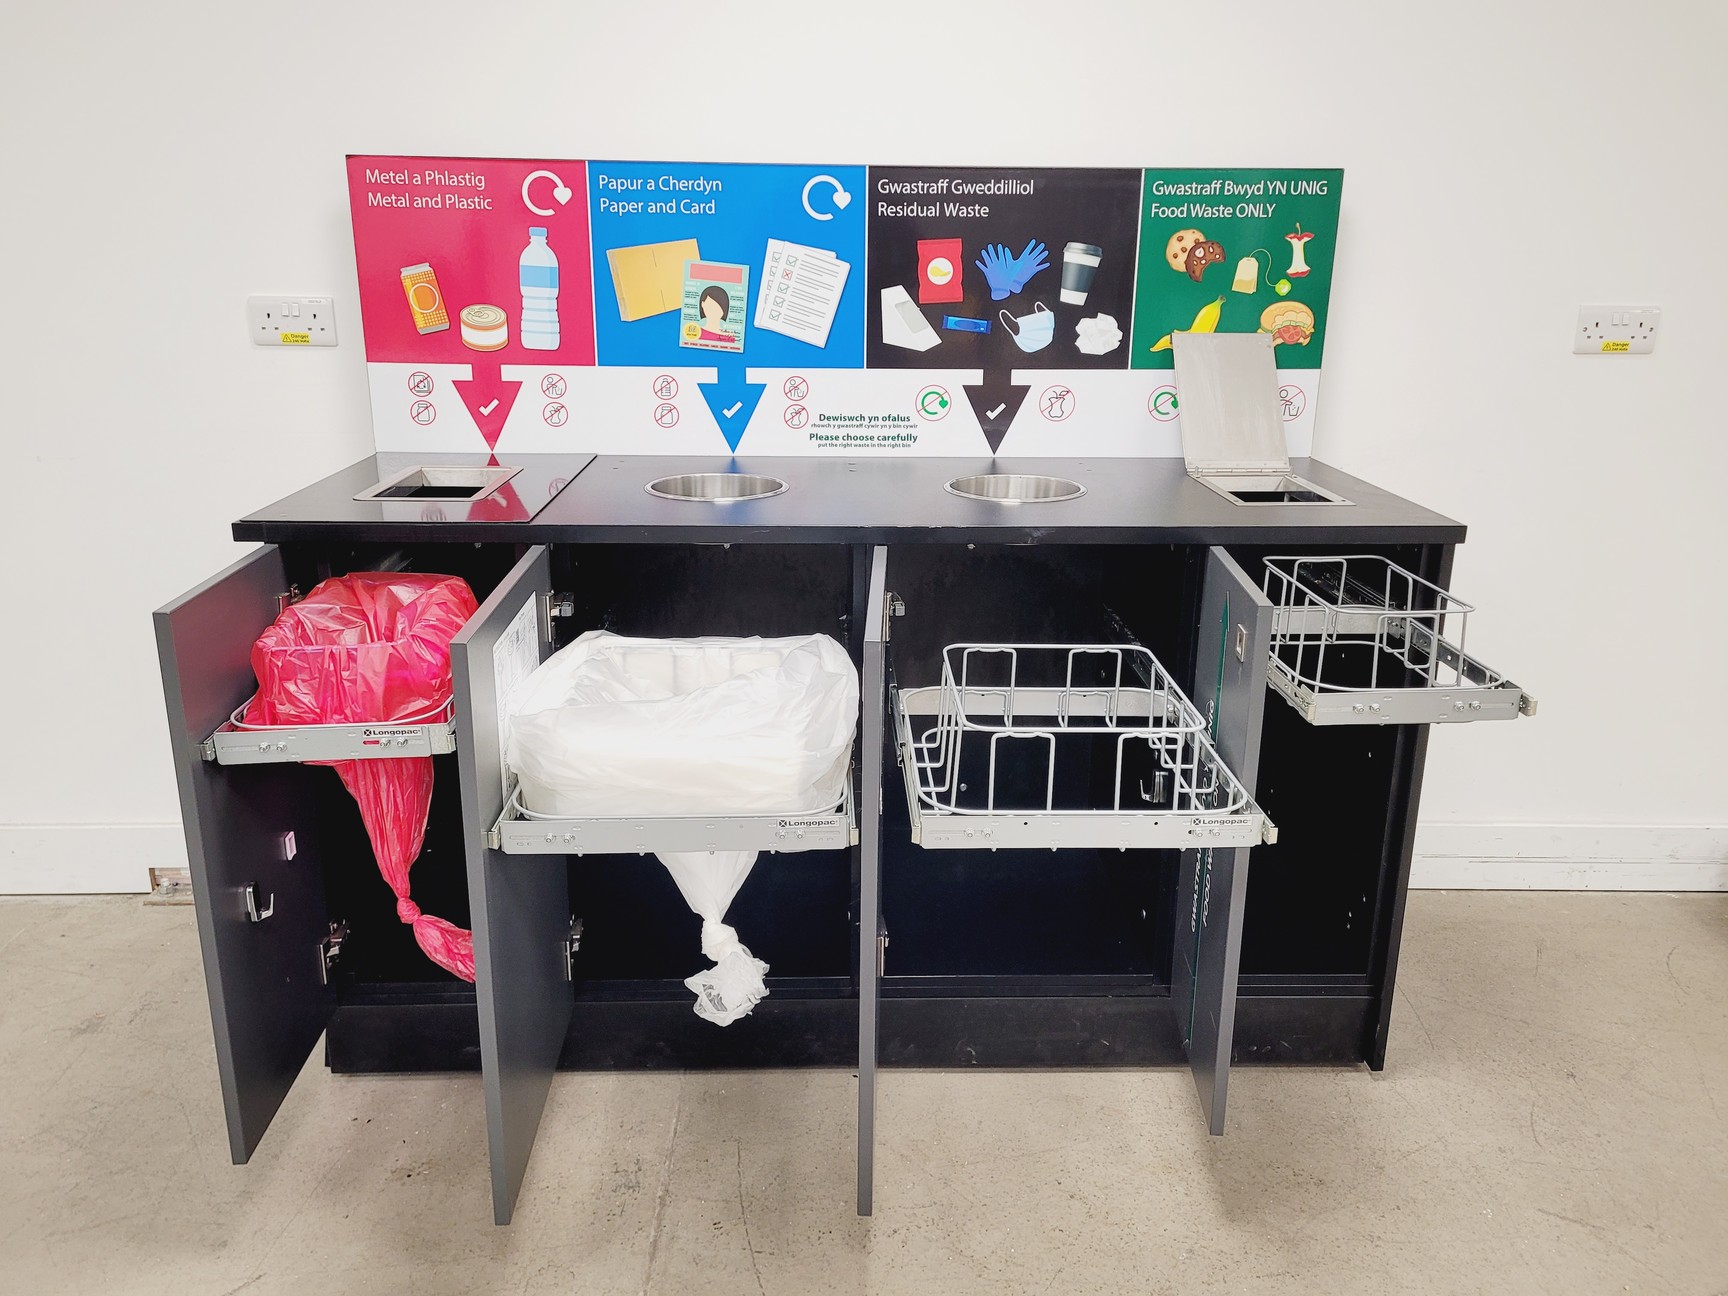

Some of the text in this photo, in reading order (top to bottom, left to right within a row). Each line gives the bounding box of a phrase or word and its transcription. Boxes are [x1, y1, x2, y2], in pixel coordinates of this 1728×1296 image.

[365, 168, 485, 190] Metel a Phlastig
[598, 174, 722, 195] Papur a Cherdyn
[877, 178, 1034, 195] Gwastraff Gweddilliol
[1152, 180, 1328, 199] Gwastraff Bwyd YN UNIG
[368, 191, 493, 210] Metal and Plastic
[600, 197, 715, 216] Paper and Card
[877, 201, 990, 217] Residual Waste
[1151, 203, 1276, 218] Food Waste ONLY
[819, 414, 911, 424] Dewiswch yn ofalus
[809, 433, 918, 444] Please choose carefully
[1202, 873, 1211, 928] FOOD
